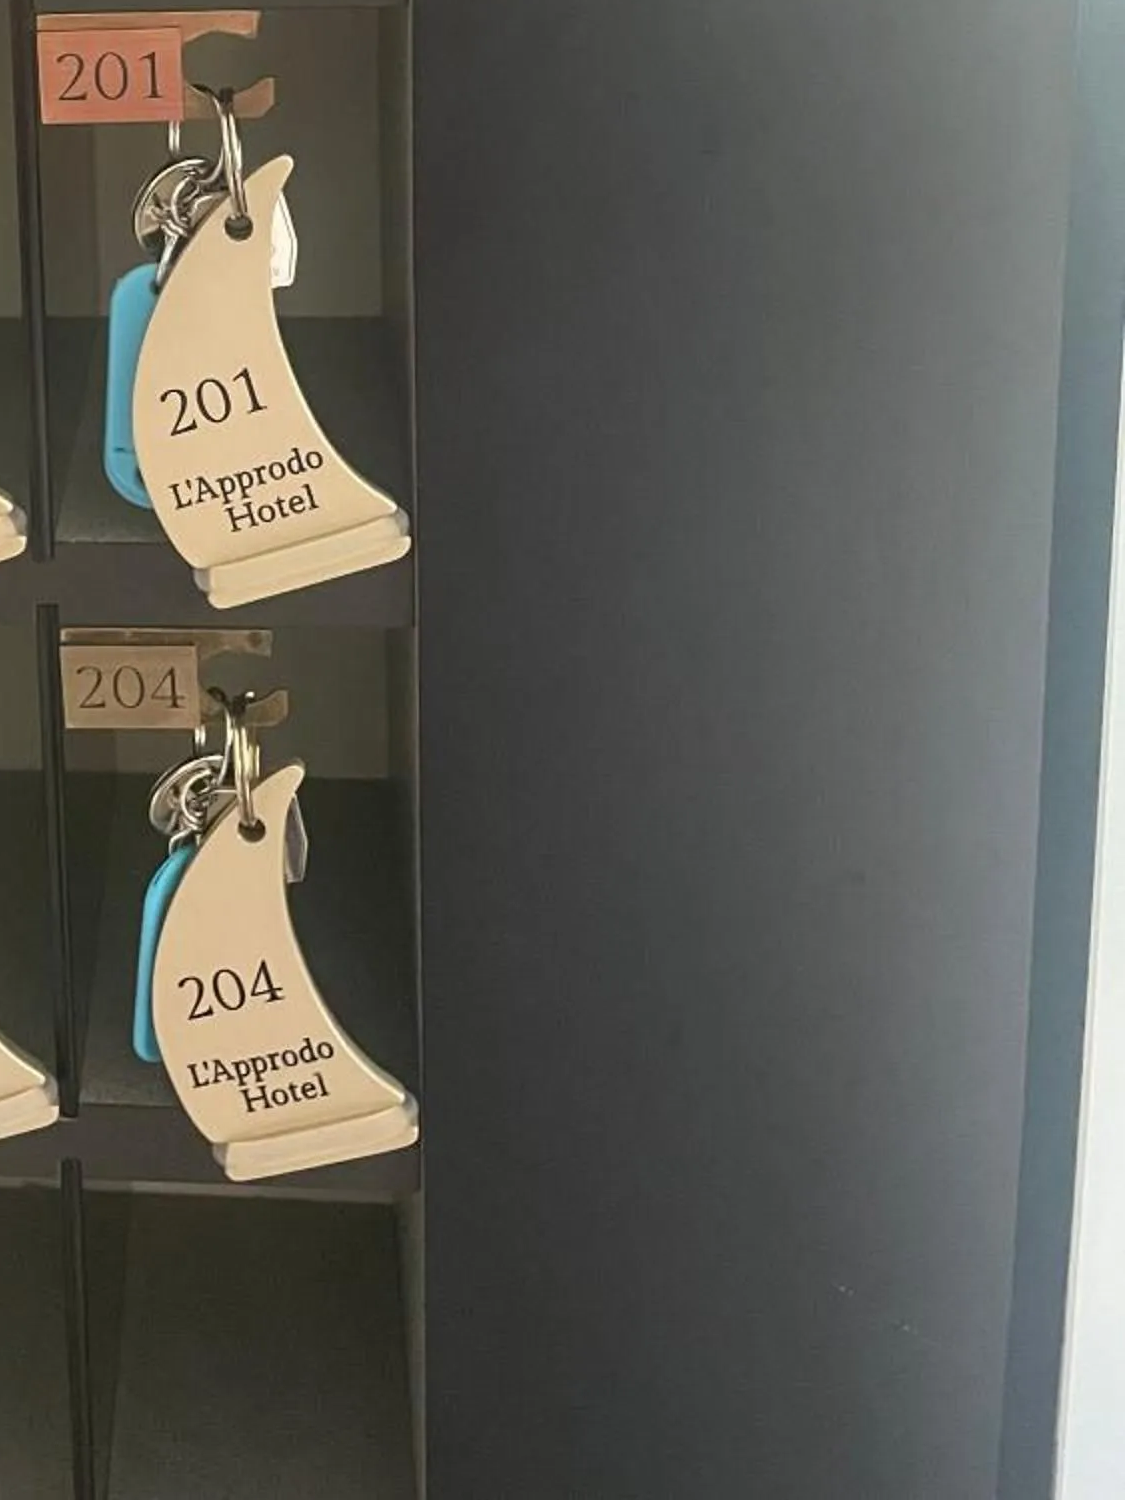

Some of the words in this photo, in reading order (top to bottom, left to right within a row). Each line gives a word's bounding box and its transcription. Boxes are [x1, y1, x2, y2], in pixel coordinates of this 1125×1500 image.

[56, 51, 163, 101] 201
[159, 367, 268, 437] 201
[168, 447, 324, 511] L'Approdo
[224, 483, 320, 533] Hotel
[76, 665, 185, 709] 204
[177, 959, 284, 1021] 204
[186, 1037, 335, 1089] L'Approdo
[239, 1072, 330, 1113] Hotel
